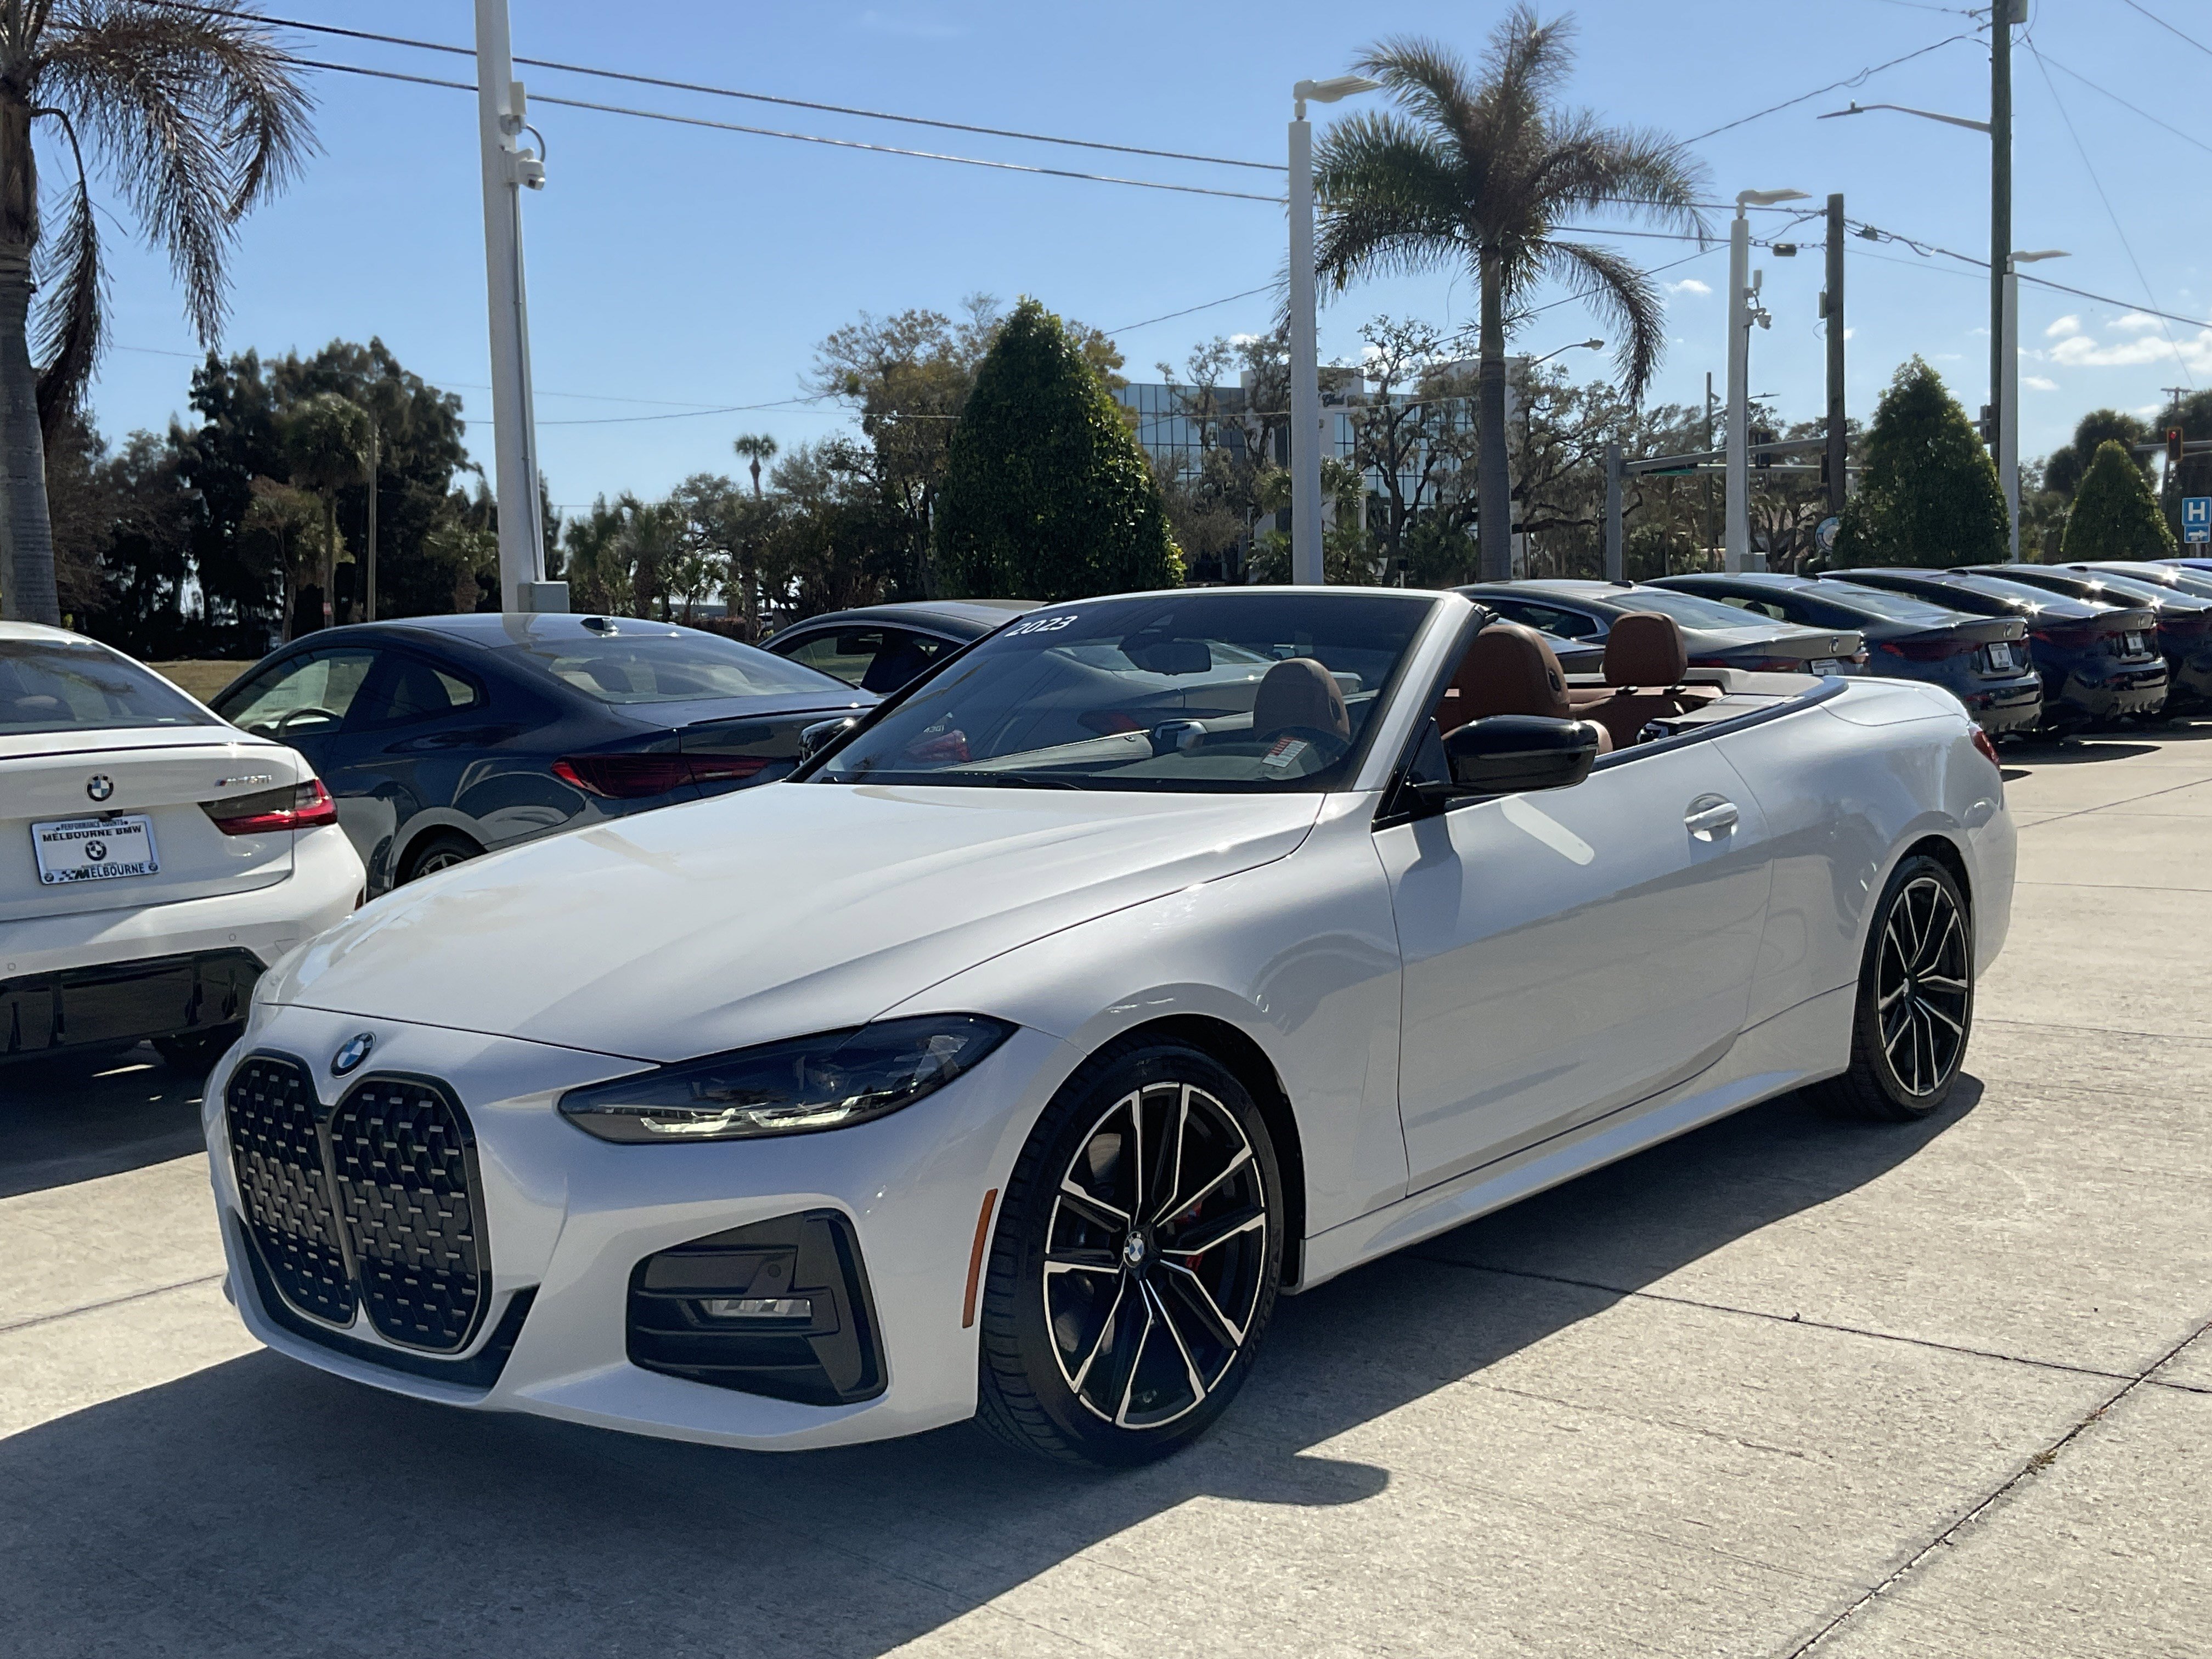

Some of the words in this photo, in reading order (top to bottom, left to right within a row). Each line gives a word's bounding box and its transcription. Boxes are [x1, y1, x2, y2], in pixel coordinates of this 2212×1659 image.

[2188, 501, 2205, 521] H
[1005, 616, 1078, 637] 2023
[43, 830, 112, 842] MELBOURNE
[116, 825, 142, 835] BMW
[75, 864, 145, 879] MELBOURNE
